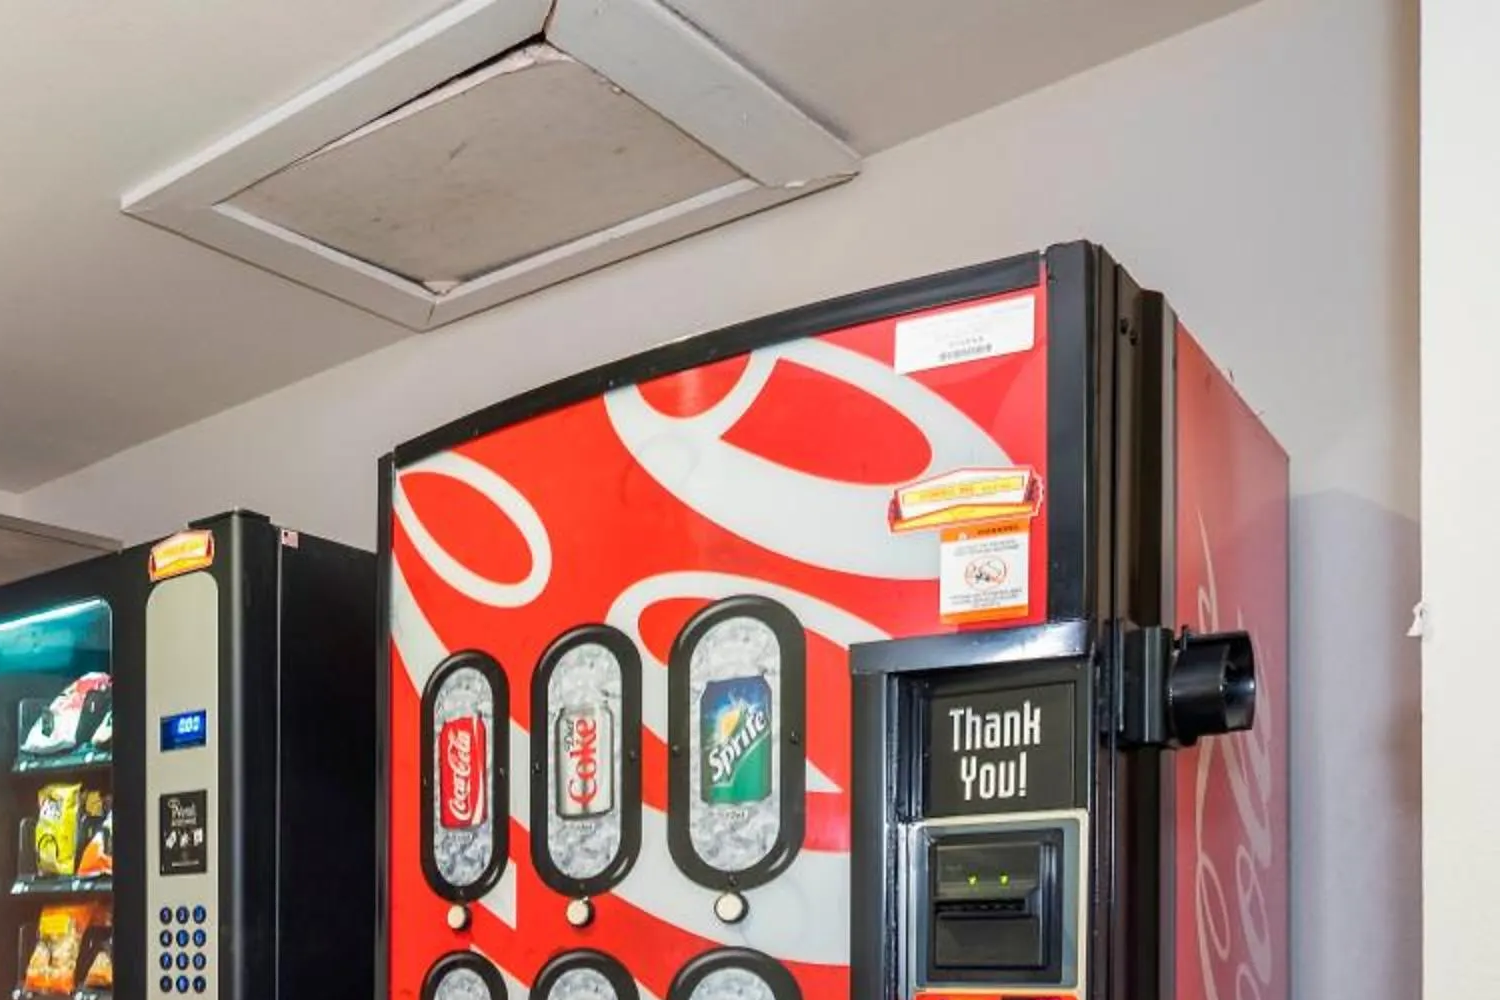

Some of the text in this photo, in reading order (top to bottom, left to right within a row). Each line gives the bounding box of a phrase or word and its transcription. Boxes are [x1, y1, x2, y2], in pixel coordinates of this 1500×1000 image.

[708, 702, 767, 783] Sprite
[948, 699, 1041, 752] Thank
[567, 717, 598, 810] Coke
[961, 751, 1027, 801] You!
